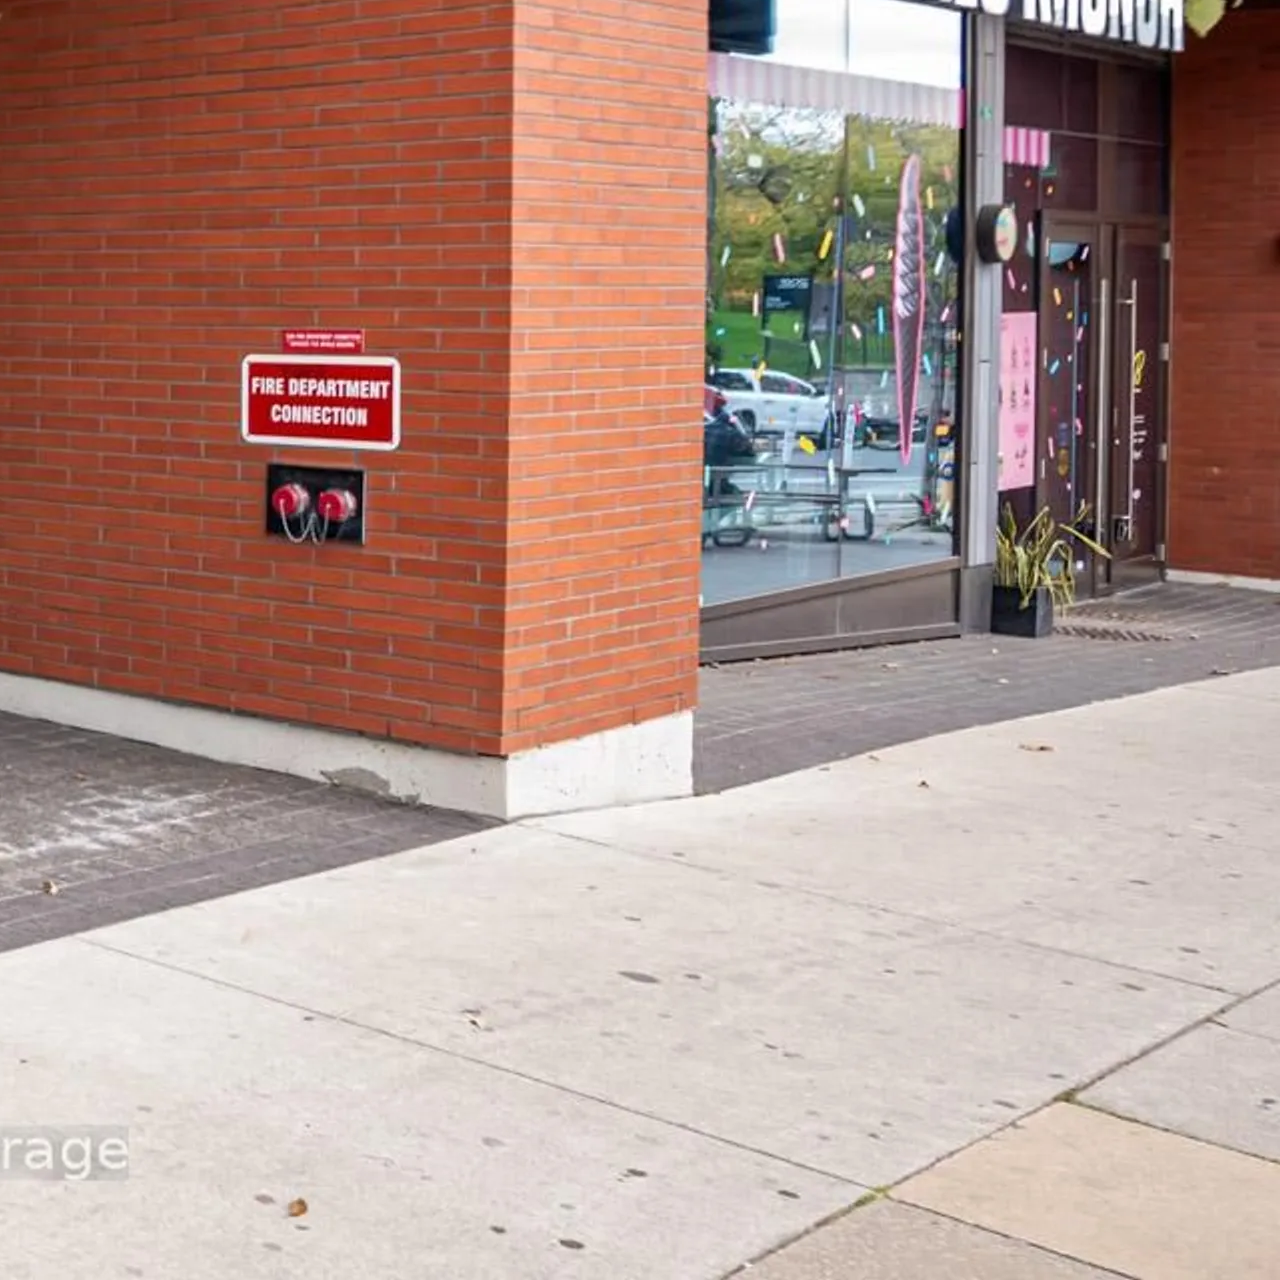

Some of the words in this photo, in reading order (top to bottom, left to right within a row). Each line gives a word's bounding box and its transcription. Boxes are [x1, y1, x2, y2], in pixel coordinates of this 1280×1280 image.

[251, 376, 285, 396] FIRE
[289, 378, 391, 400] DEPARTMENT
[270, 403, 369, 427] CONNECTION
